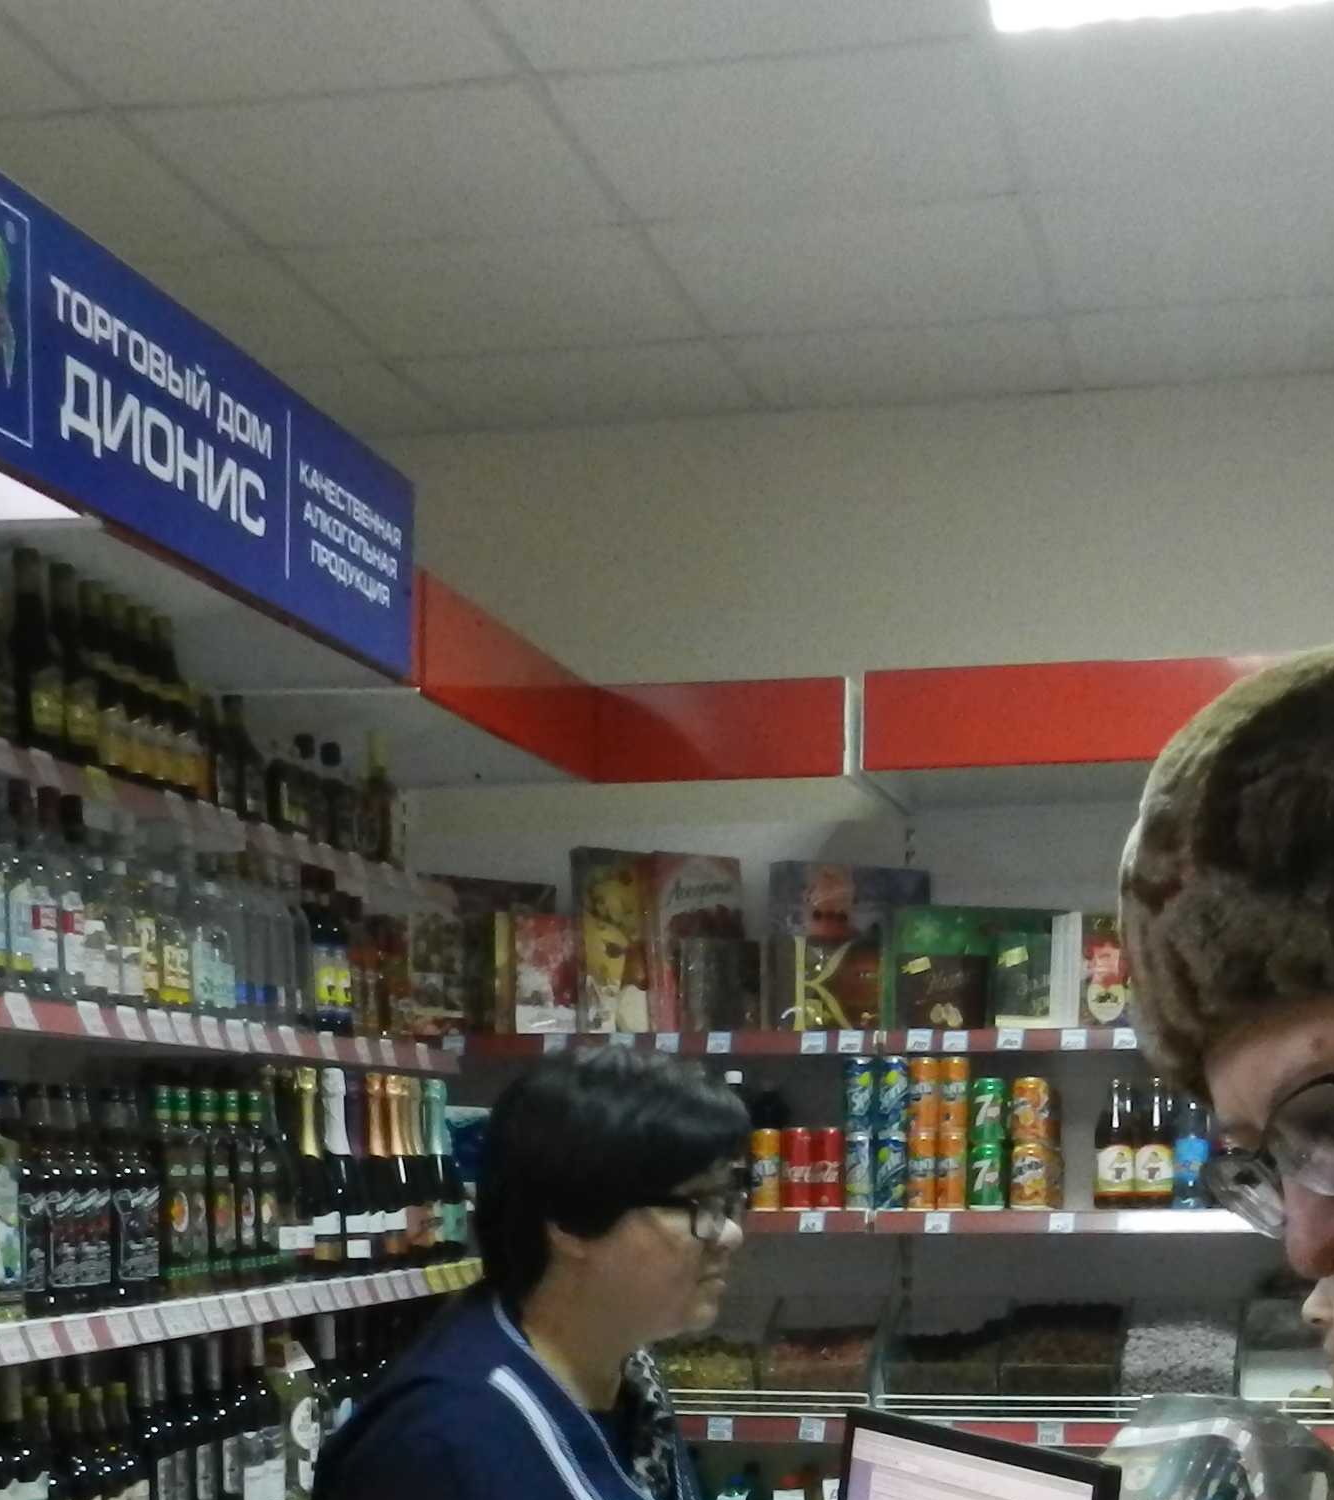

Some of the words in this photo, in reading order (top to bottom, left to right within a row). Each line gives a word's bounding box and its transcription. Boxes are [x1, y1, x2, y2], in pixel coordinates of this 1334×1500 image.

[50, 275, 211, 419] ТОРГОВЫЙ
[217, 391, 272, 460] ДОМ
[60, 354, 266, 537] ДИОНИС
[299, 459, 402, 551] КАЧЕСТВЕННАЯ
[303, 501, 398, 580] АЛКОГОЛЬНАЯ
[311, 539, 390, 608] ПРОДУКЦИЯ
